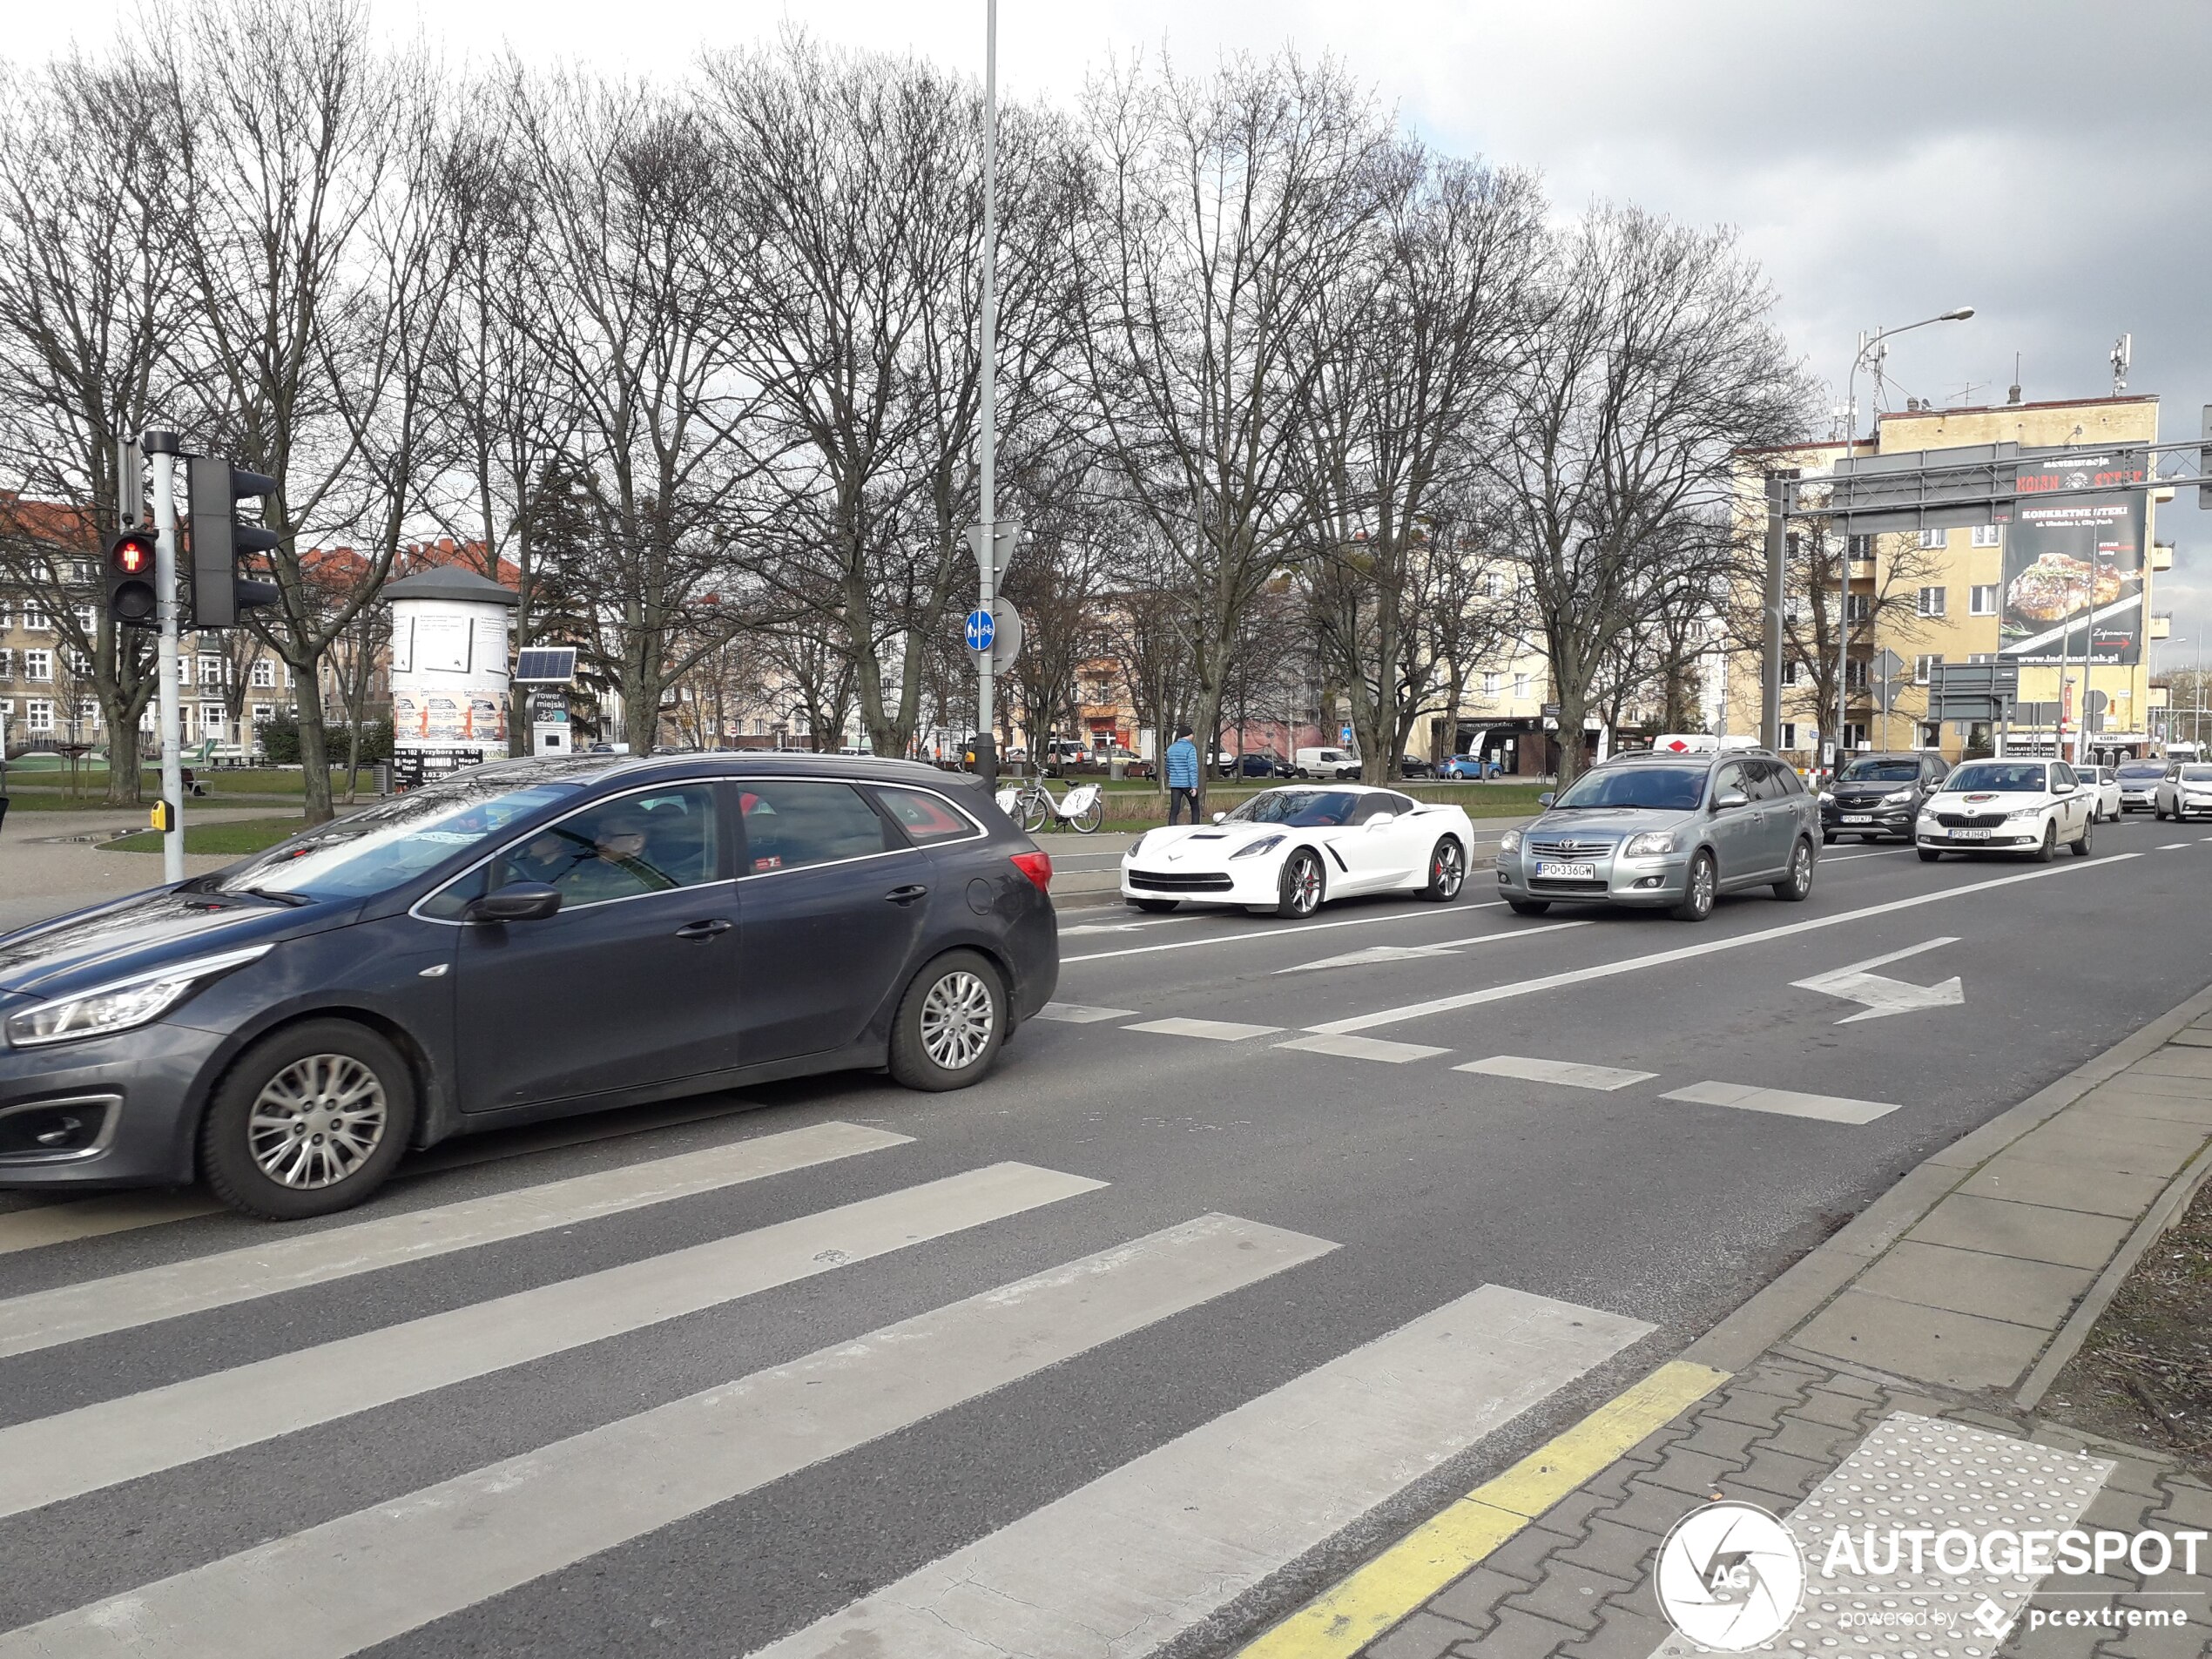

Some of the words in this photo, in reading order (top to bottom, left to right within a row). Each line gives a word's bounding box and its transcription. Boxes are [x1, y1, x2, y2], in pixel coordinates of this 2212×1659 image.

[2022, 509, 2091, 519] KONKRETNE
[2093, 507, 2128, 516] STEKI
[536, 700, 565, 709] miejski
[423, 758, 452, 766] MUMIO
[1542, 865, 1557, 874] PO
[1561, 865, 1592, 875] 336GW
